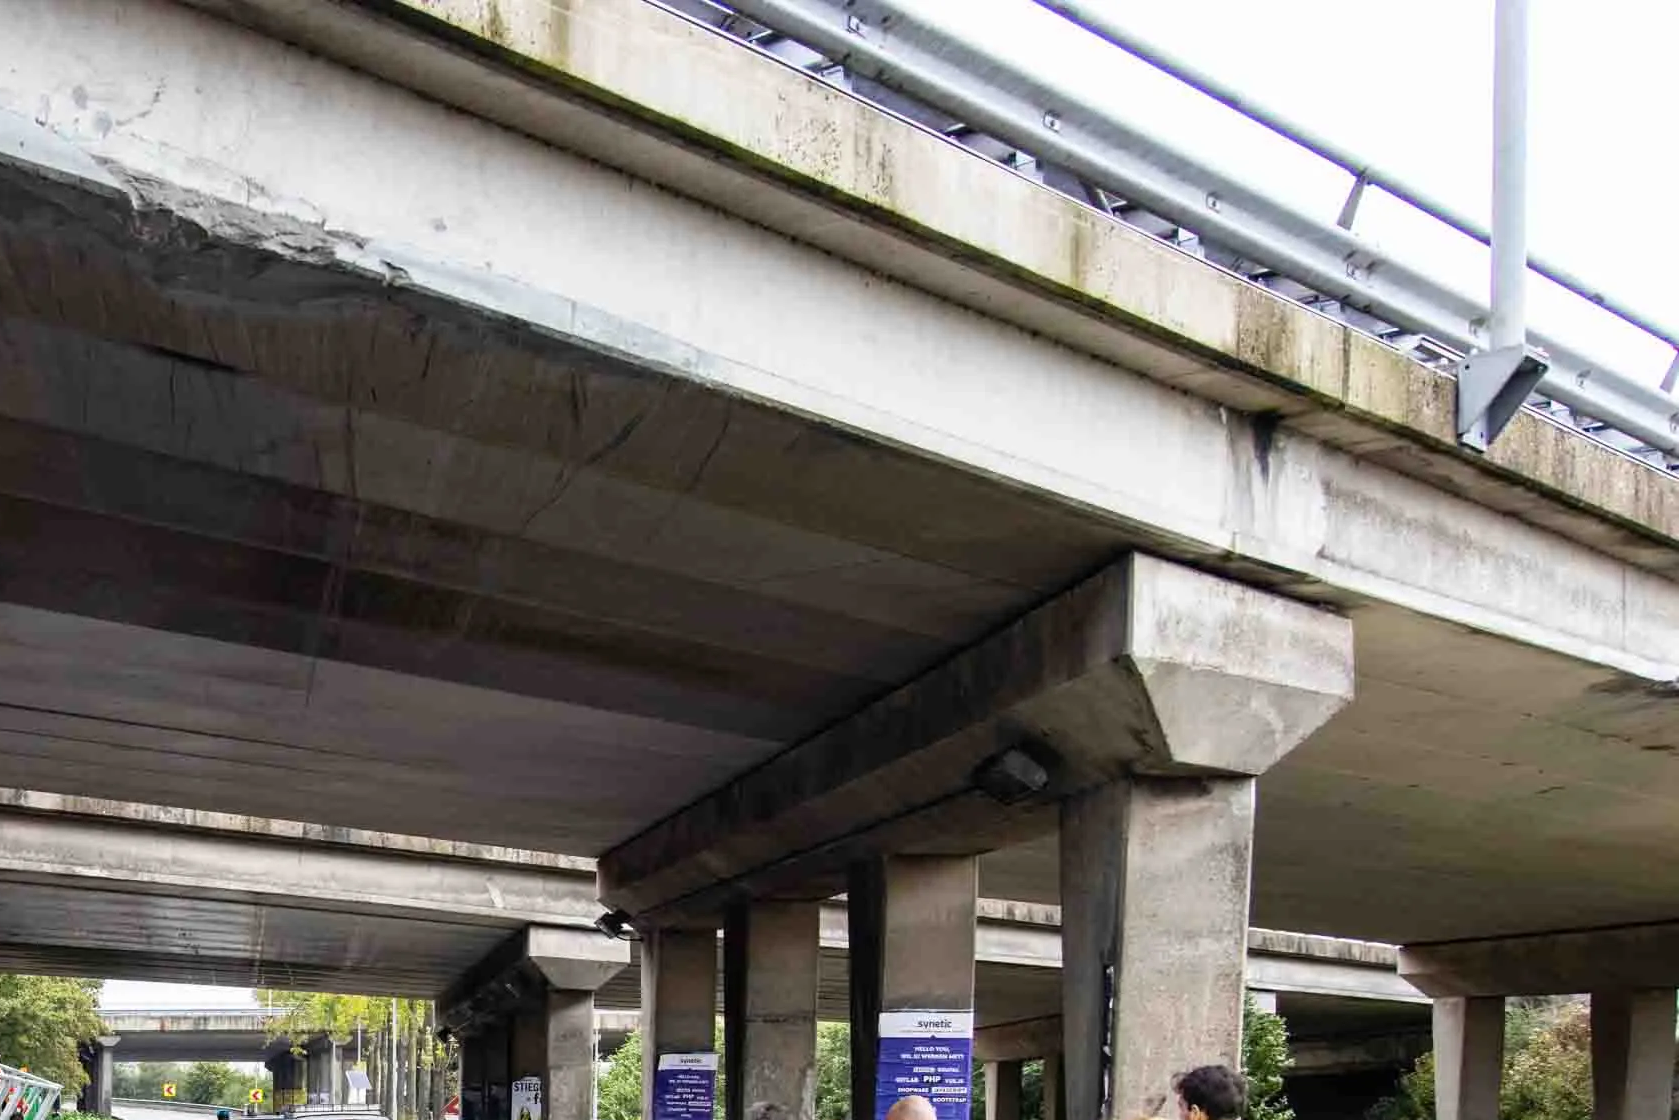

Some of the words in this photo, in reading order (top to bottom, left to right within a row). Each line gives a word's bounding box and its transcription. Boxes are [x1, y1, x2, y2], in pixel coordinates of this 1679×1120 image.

[917, 1018, 952, 1029] synetic
[923, 1075, 941, 1083] PHP
[514, 1082, 542, 1092] STIEG
